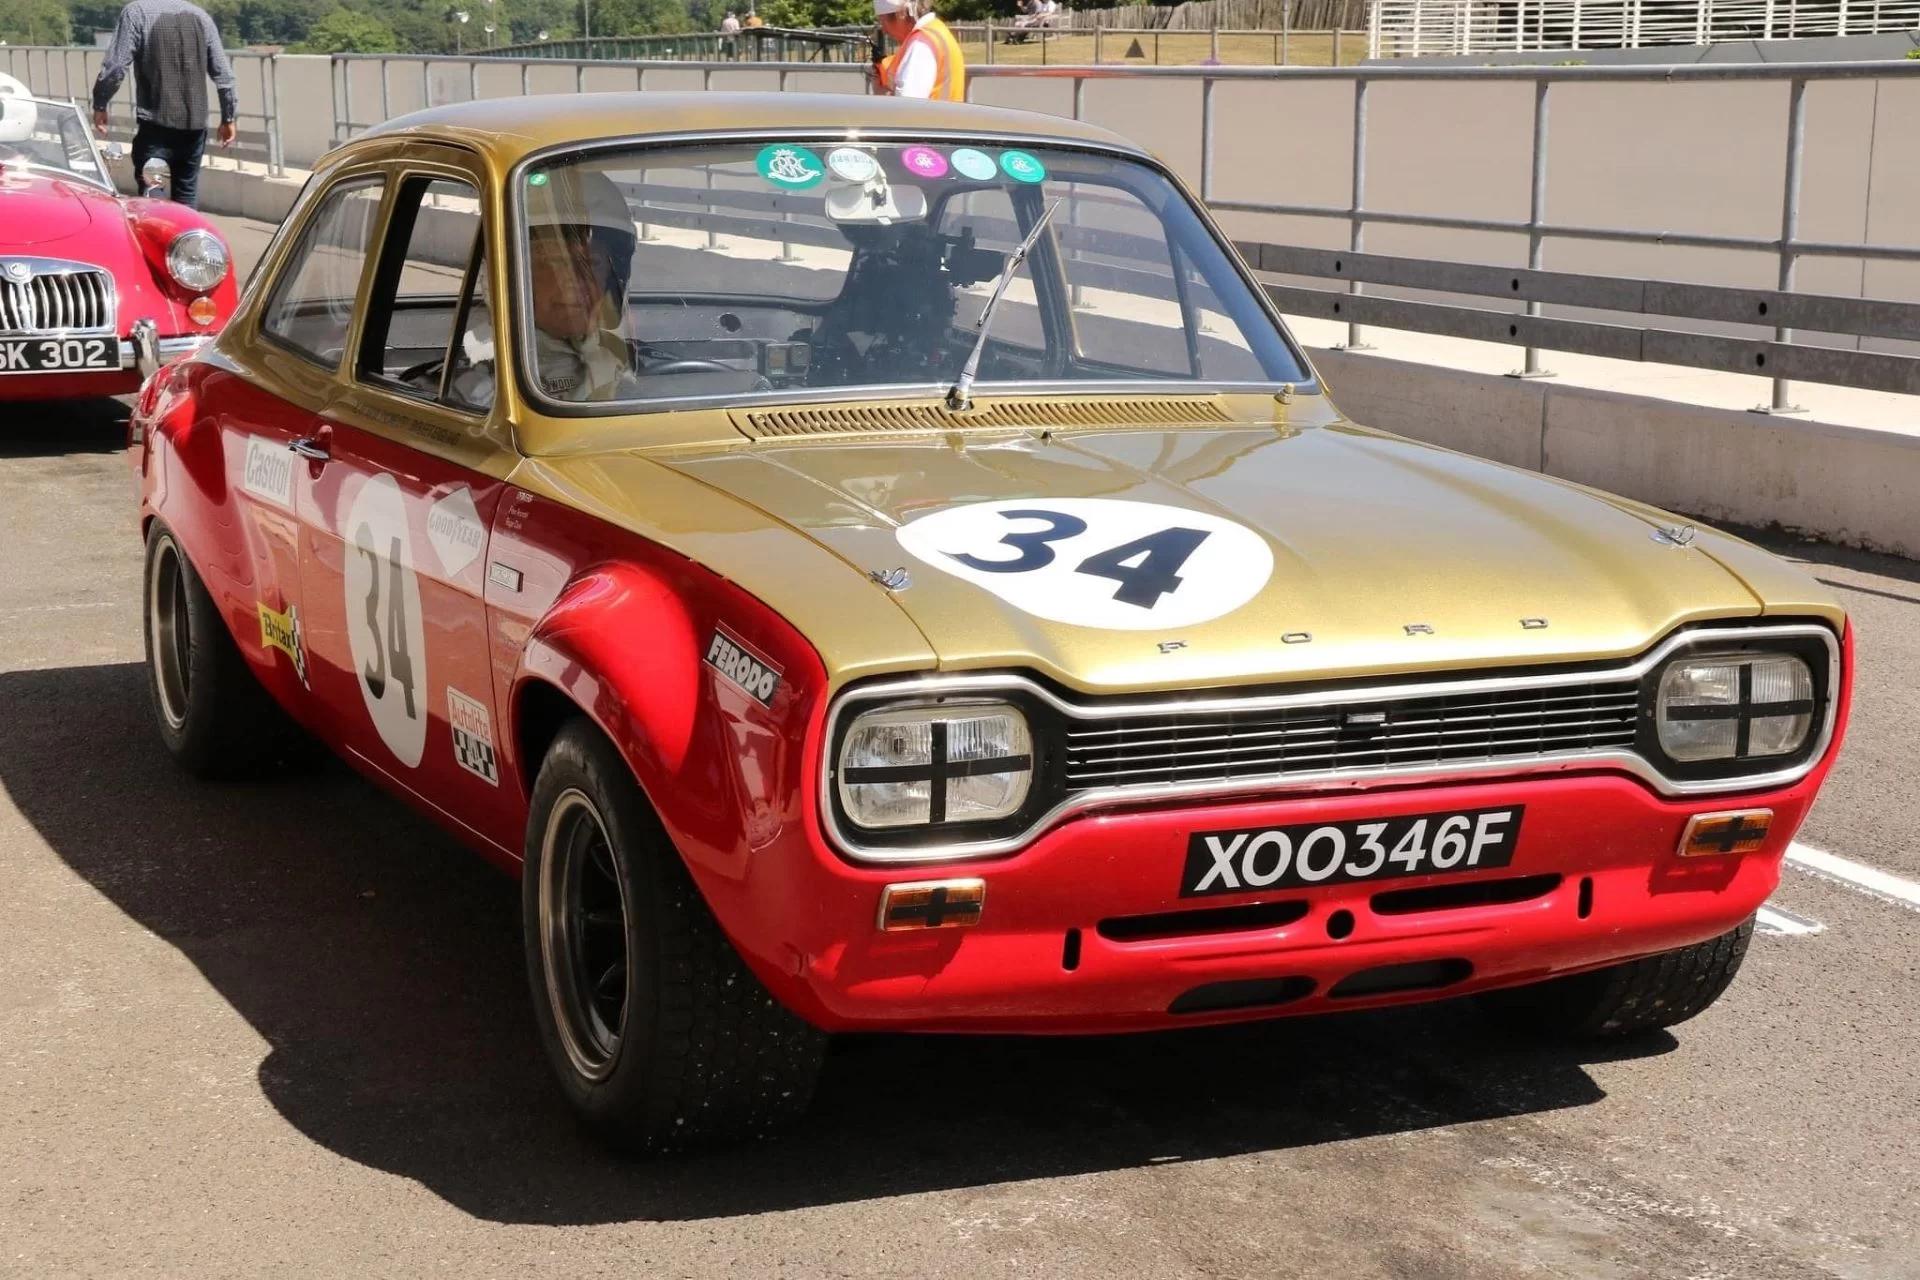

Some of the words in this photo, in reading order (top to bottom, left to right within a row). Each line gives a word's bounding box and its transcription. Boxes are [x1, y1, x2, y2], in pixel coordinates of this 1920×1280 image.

[40, 340, 107, 368] 302
[246, 442, 292, 497] Castrol
[429, 511, 481, 549] GOODYEAR
[938, 509, 1212, 610] 34
[262, 612, 293, 649] Britax
[354, 520, 417, 720] 34
[1156, 616, 1549, 654] FORD
[707, 634, 774, 700] FERODO
[451, 695, 490, 742] Autolite
[1193, 811, 1512, 892] XOO346F
